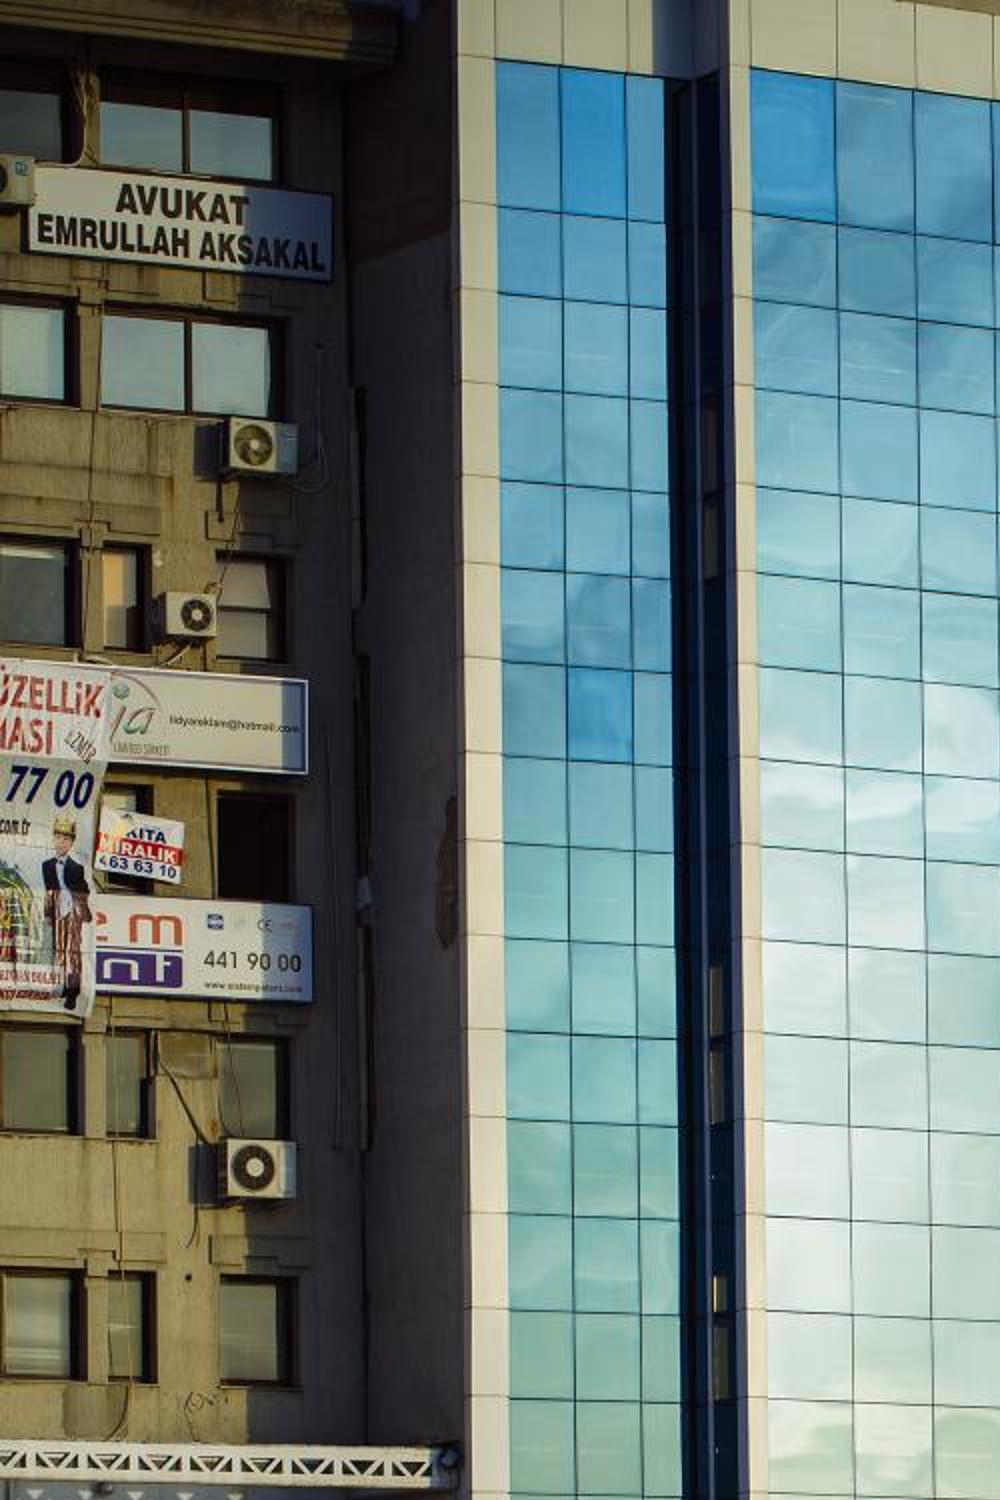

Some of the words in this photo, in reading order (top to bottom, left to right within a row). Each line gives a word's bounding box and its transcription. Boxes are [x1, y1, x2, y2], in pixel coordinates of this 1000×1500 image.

[115, 183, 250, 226] AVUKAT
[37, 213, 190, 259] EMRULLAH
[199, 231, 325, 272] AKSAKAL
[5, 764, 49, 804] 77
[53, 768, 95, 809] 00
[203, 949, 238, 968] 441
[247, 952, 271, 971] 90
[278, 953, 302, 973] 00
